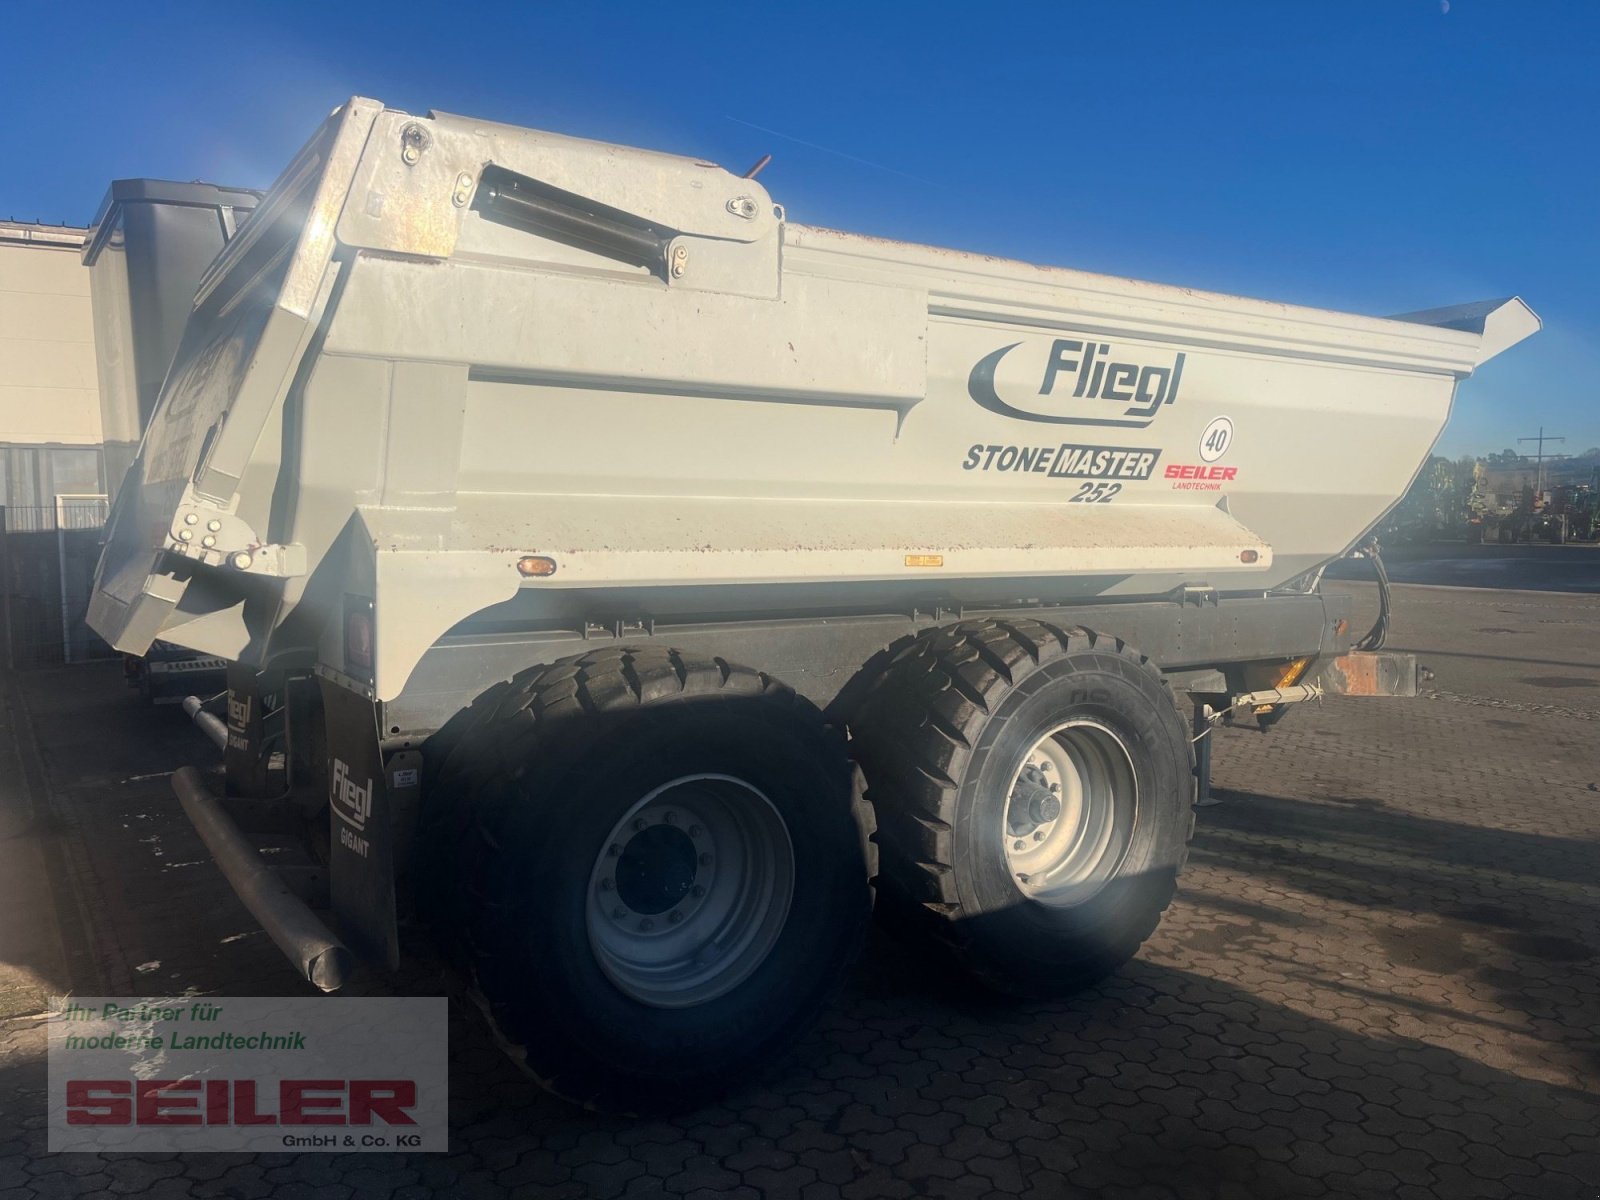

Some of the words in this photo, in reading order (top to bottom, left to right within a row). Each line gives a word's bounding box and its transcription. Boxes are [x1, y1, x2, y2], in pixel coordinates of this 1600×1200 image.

[1038, 339, 1186, 417] Fliegl
[1205, 428, 1227, 452] 40
[962, 443, 1056, 473] STONE
[1053, 447, 1156, 478] MASTER
[1164, 464, 1238, 481] SEILER
[1068, 482, 1122, 503] 252
[1172, 482, 1222, 491] LANDTECHNIK
[333, 758, 373, 824] Fliegl
[340, 826, 370, 859] GIGANT
